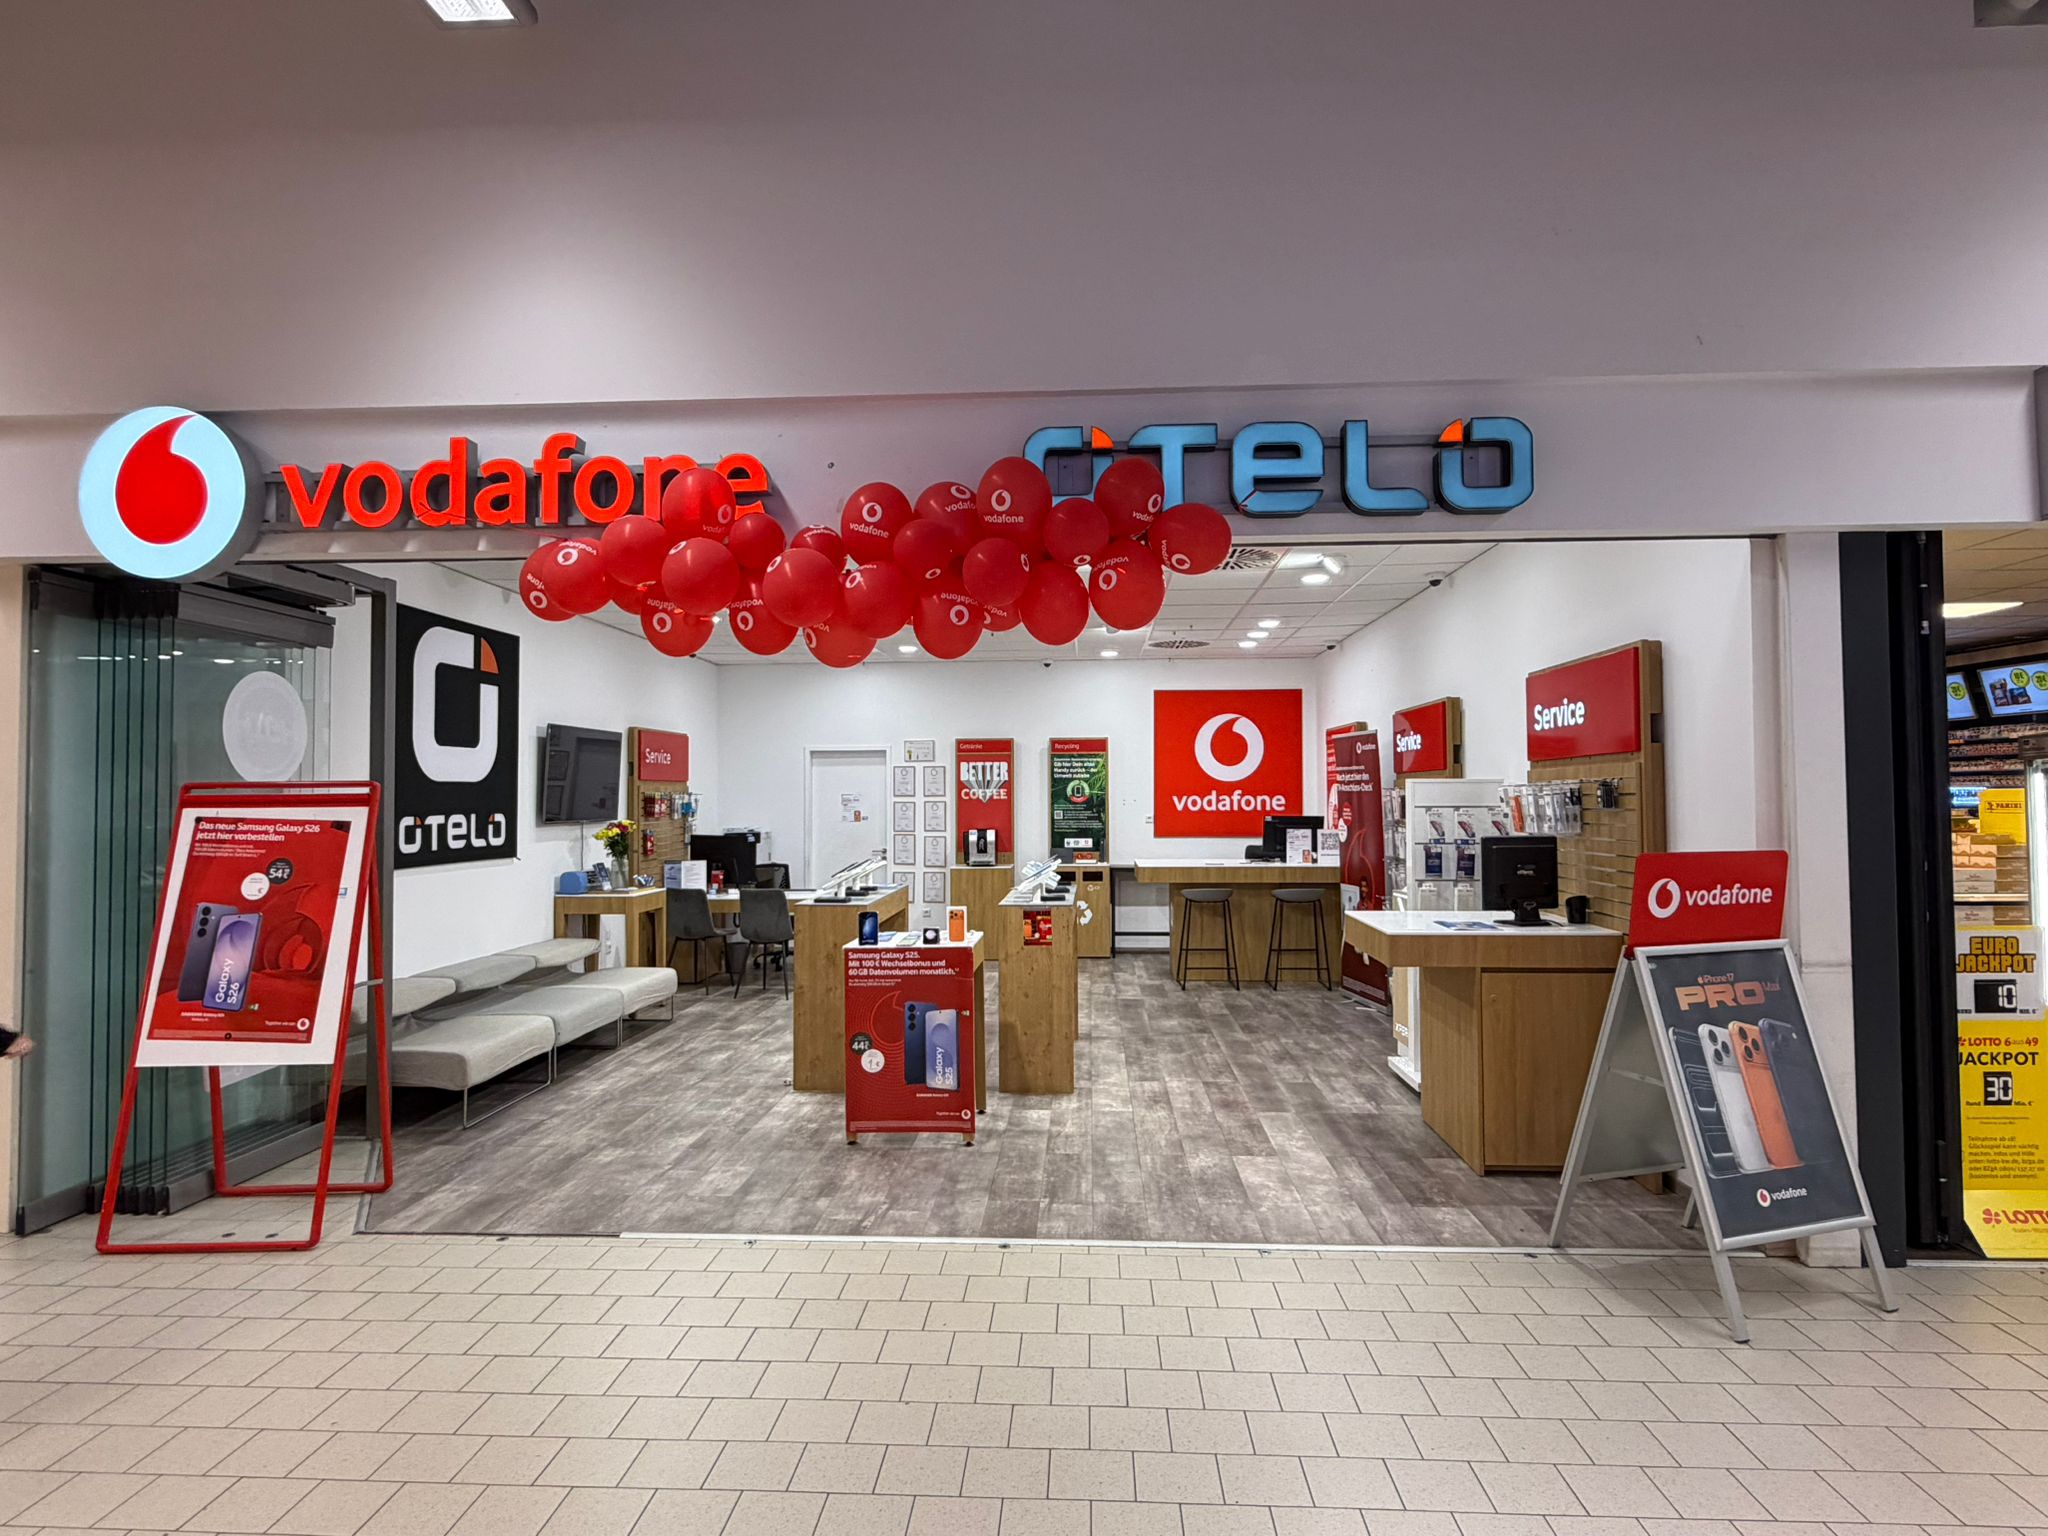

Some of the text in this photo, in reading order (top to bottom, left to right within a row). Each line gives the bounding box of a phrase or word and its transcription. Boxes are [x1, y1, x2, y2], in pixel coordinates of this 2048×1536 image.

[279, 432, 770, 528] vodafone
[983, 513, 1025, 524] vodafone
[849, 522, 890, 539] vodafone
[1533, 697, 1586, 732] Service
[1054, 742, 1080, 750] Recycling
[1396, 731, 1422, 753] Service
[645, 747, 672, 766] Service
[960, 761, 1009, 781] BETTER
[960, 788, 1008, 800] COFFEE
[1172, 789, 1286, 812] vodafone
[1995, 801, 2023, 809] PANINI
[195, 831, 286, 842] jetzt hier vorbestellen
[199, 821, 321, 833] Das neue Samsung Galaxy S26
[1685, 884, 1773, 907] vodafone
[1969, 935, 2019, 956] EURO
[848, 951, 921, 960] Samsung Galaxy S25.
[1956, 953, 2037, 973] JACKPOT
[215, 958, 235, 1003] Galaxy
[848, 968, 858, 976] 60
[858, 968, 868, 976] GB
[869, 968, 919, 976] Datenvolumen
[1702, 972, 1735, 984] iPhone 17
[227, 982, 240, 1004] S26
[1674, 981, 1766, 1012] PRO
[1998, 984, 2016, 1009] 10
[1968, 1037, 2002, 1047] LOTTO
[2004, 1037, 2012, 1047] 6
[2025, 1037, 2039, 1047] 49
[935, 1046, 945, 1085] Galaxy
[944, 1066, 953, 1085] S25
[1986, 1076, 2013, 1102] 30
[1771, 1186, 1808, 1202] vodafone
[2001, 1209, 2048, 1225] LOTT
